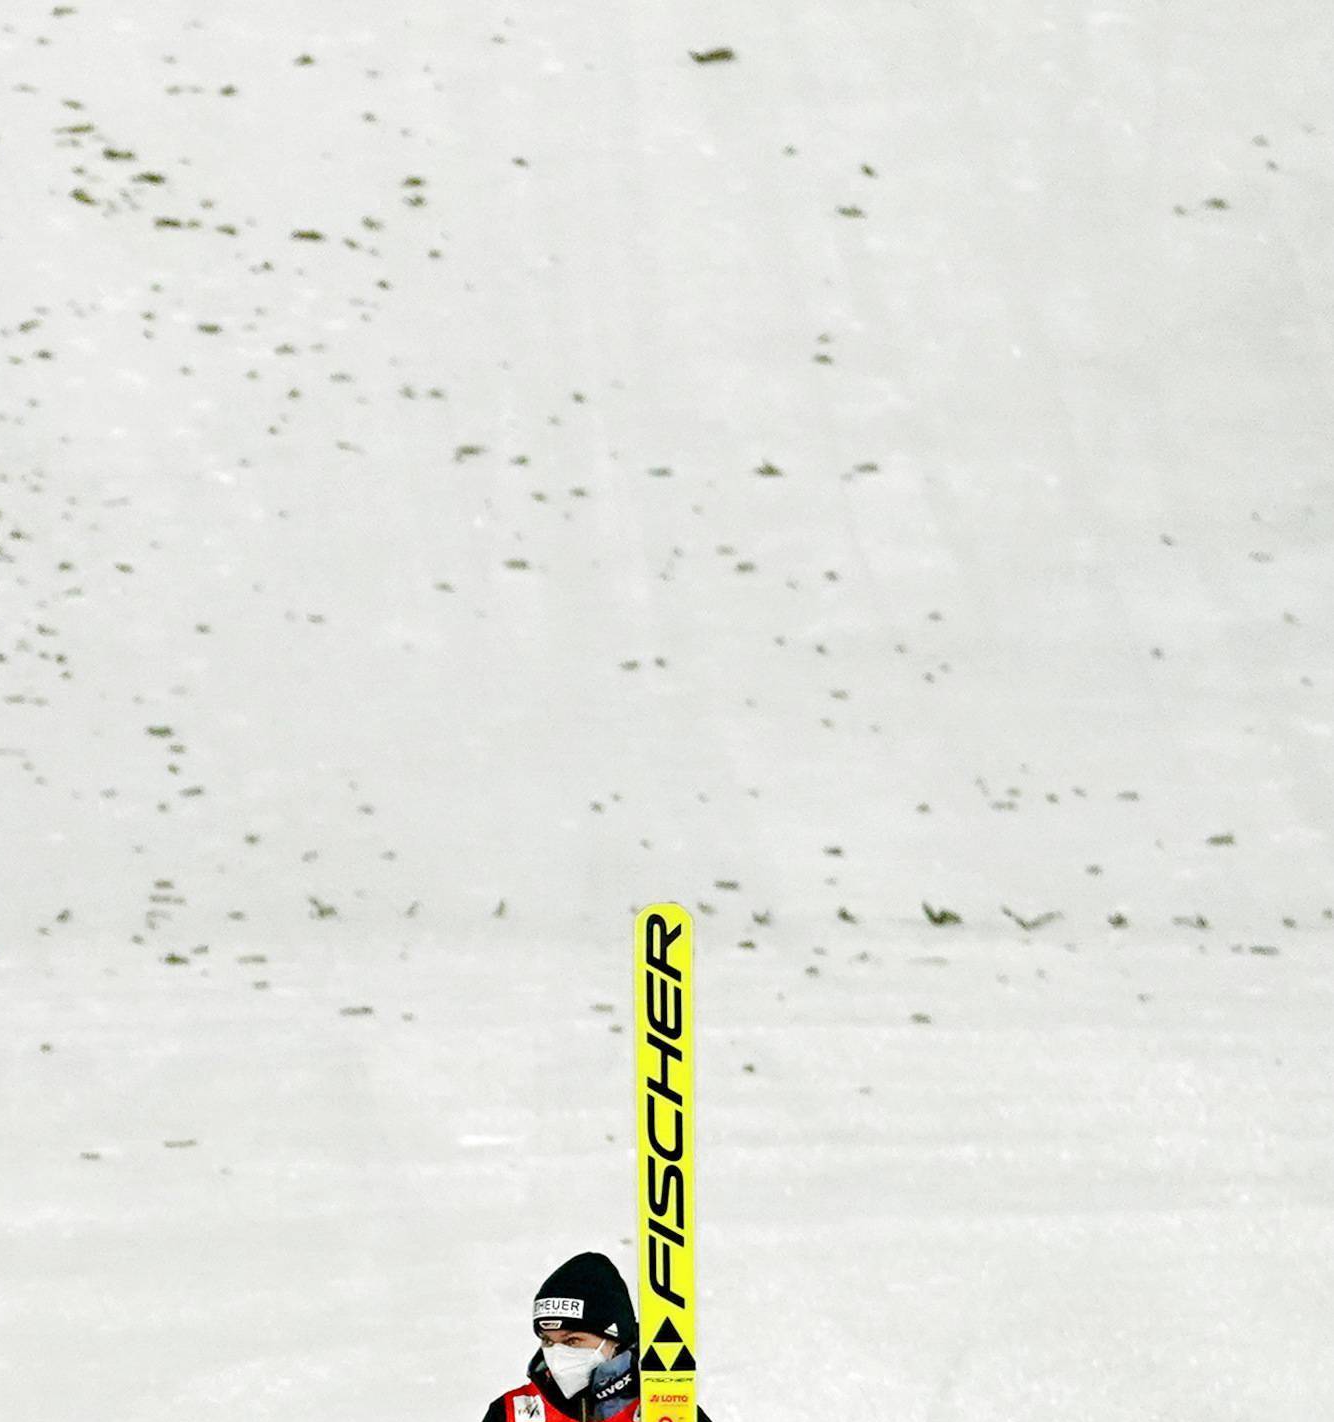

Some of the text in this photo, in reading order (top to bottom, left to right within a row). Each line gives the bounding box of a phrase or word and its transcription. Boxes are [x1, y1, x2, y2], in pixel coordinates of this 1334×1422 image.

[646, 913, 686, 1309] FISCHER
[596, 1373, 632, 1400] uvex
[661, 1395, 689, 1403] LOTTO
